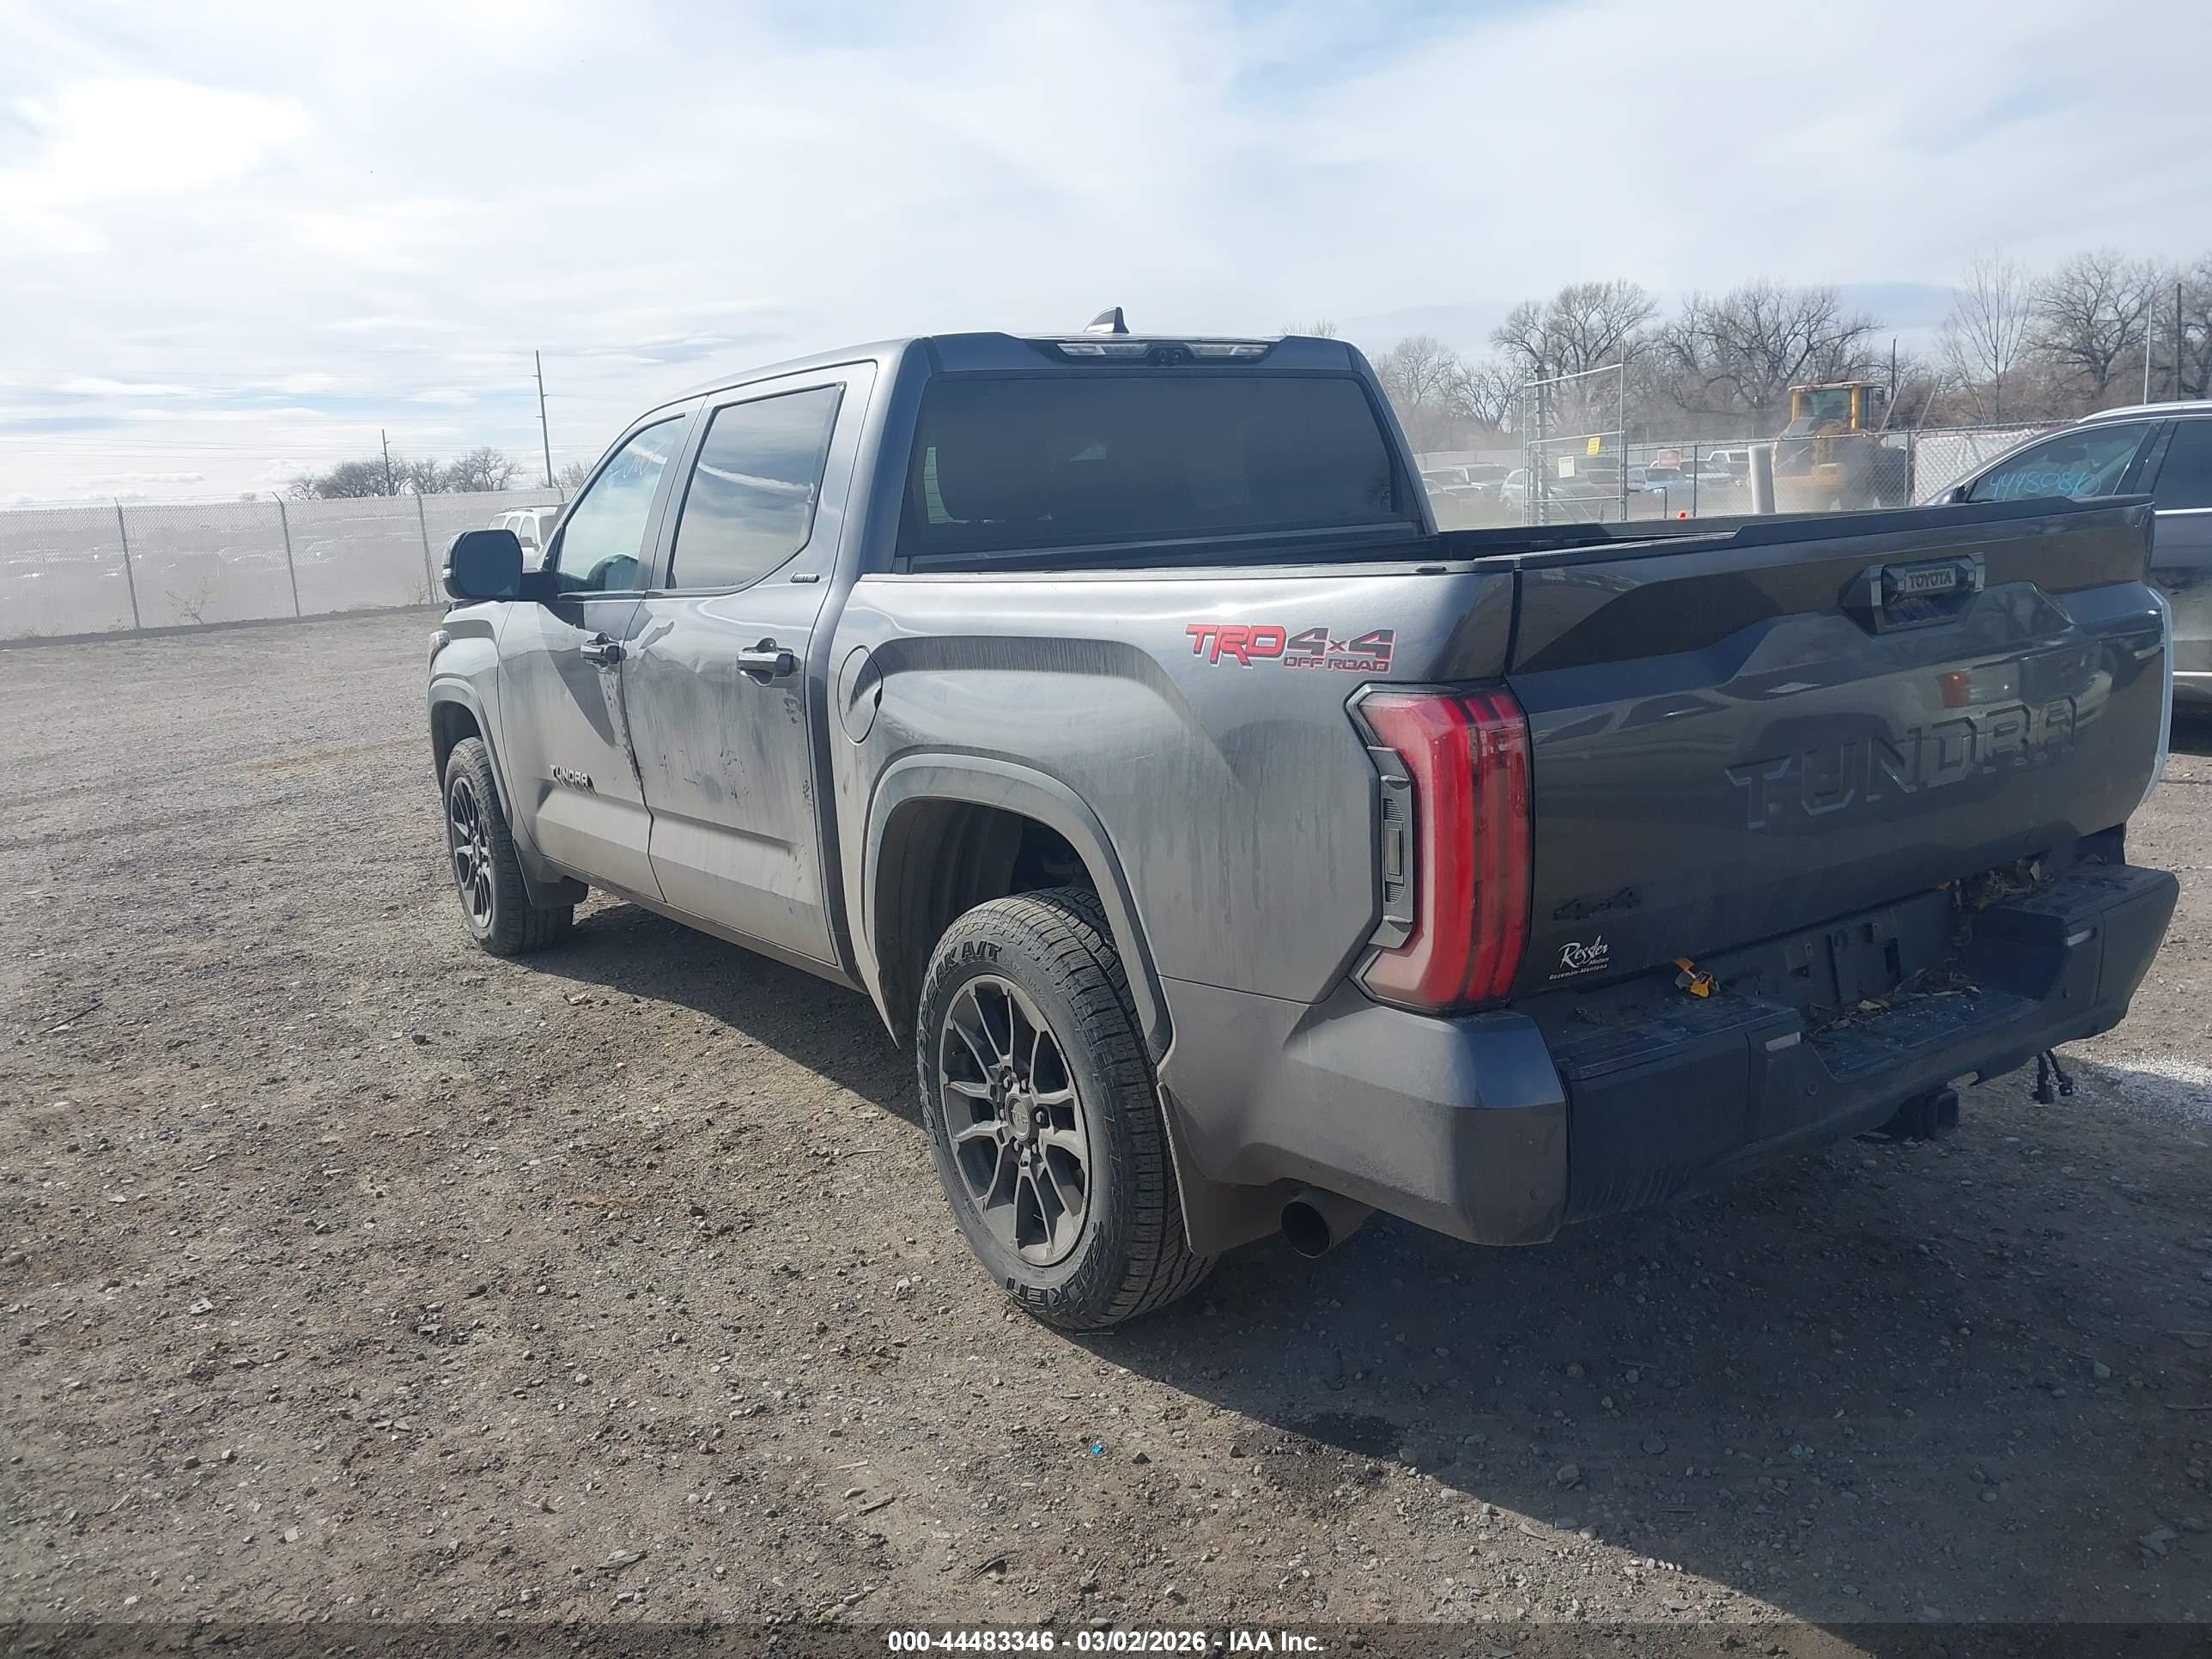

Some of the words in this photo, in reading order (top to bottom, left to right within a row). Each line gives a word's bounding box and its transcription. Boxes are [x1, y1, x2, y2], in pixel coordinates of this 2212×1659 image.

[1910, 570, 1953, 589] TOYOTA
[1185, 623, 1287, 670] TRD
[1284, 657, 1326, 669] OFF
[1327, 659, 1391, 674] ROAD
[1724, 693, 2077, 830] TUNDRA
[550, 763, 594, 787] TUNDRA
[961, 940, 1002, 963] A/T
